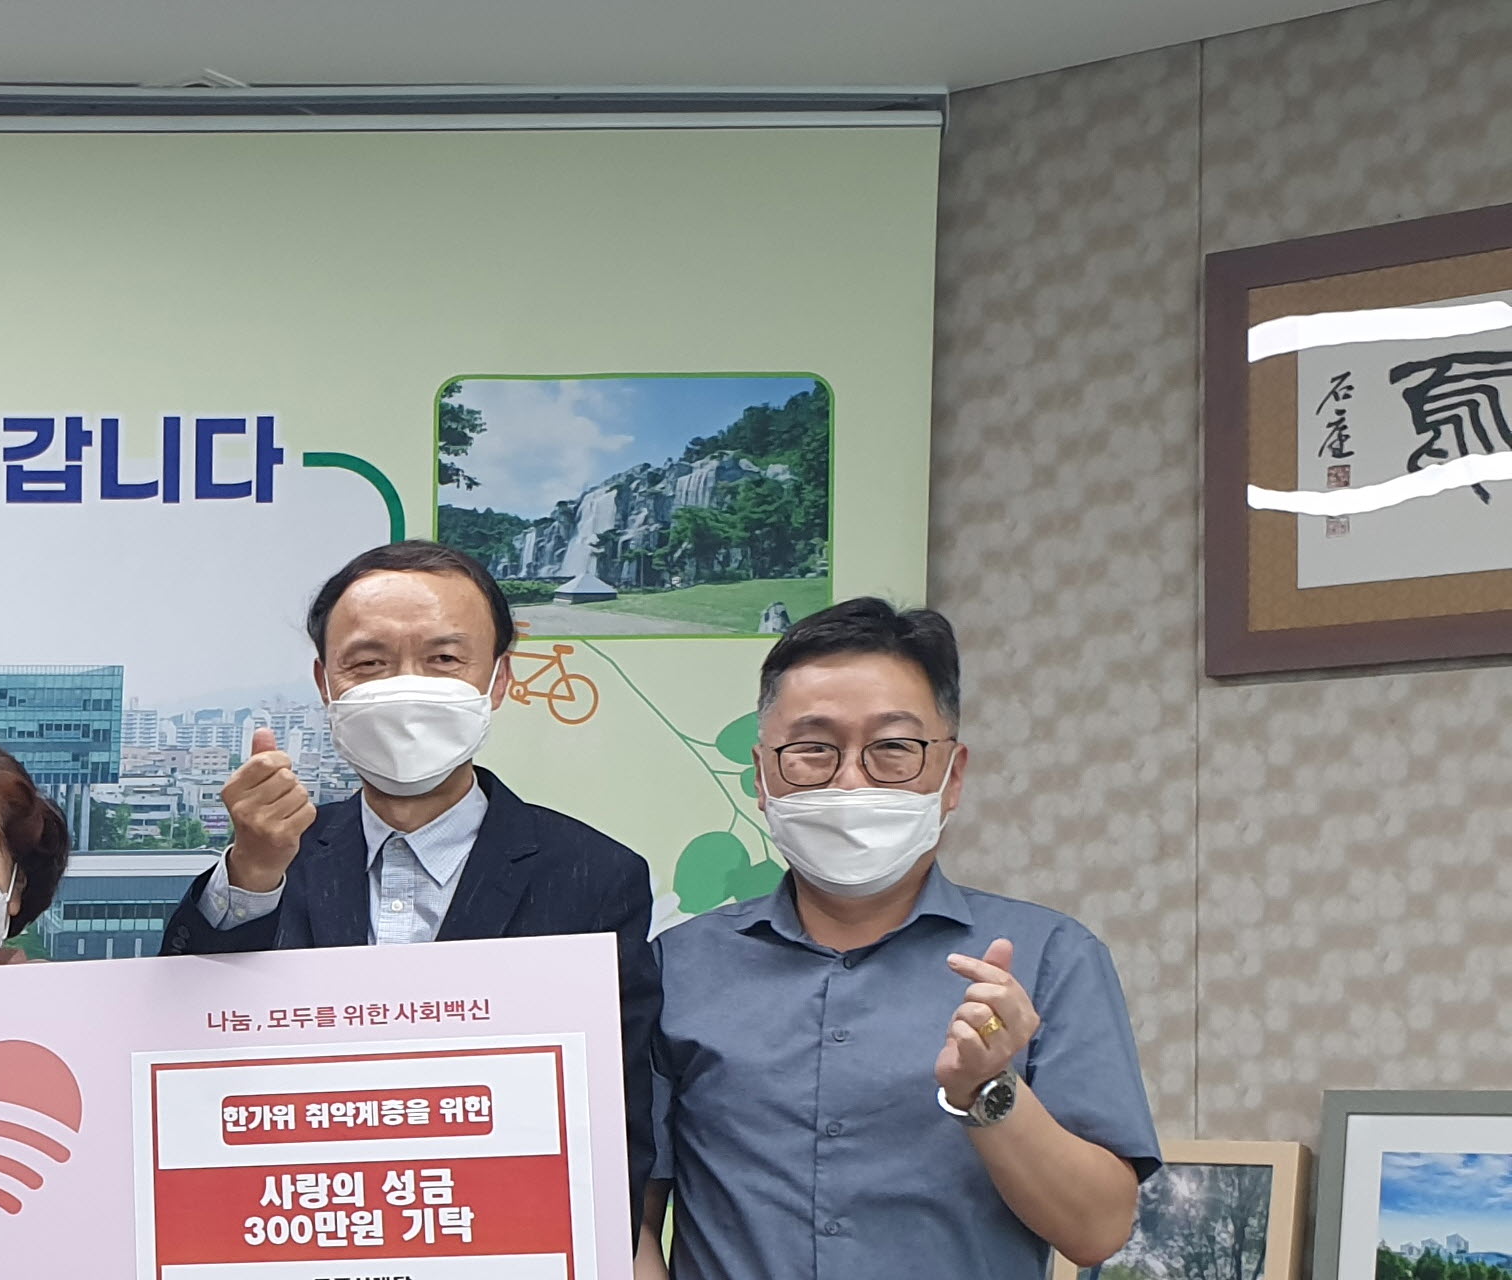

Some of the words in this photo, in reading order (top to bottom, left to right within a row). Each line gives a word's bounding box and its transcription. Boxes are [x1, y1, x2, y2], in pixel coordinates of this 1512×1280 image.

[267, 1006, 338, 1029] 모두를
[342, 1003, 390, 1026] 위한
[394, 998, 491, 1023] 사회백신
[222, 1104, 296, 1132] 한가위
[305, 1099, 431, 1129] 취약계층을
[439, 1095, 492, 1123] 위한
[260, 1172, 365, 1210] 사랑의
[381, 1168, 455, 1206] 성금
[244, 1208, 385, 1248] 300만원
[401, 1206, 475, 1244] 기탁
